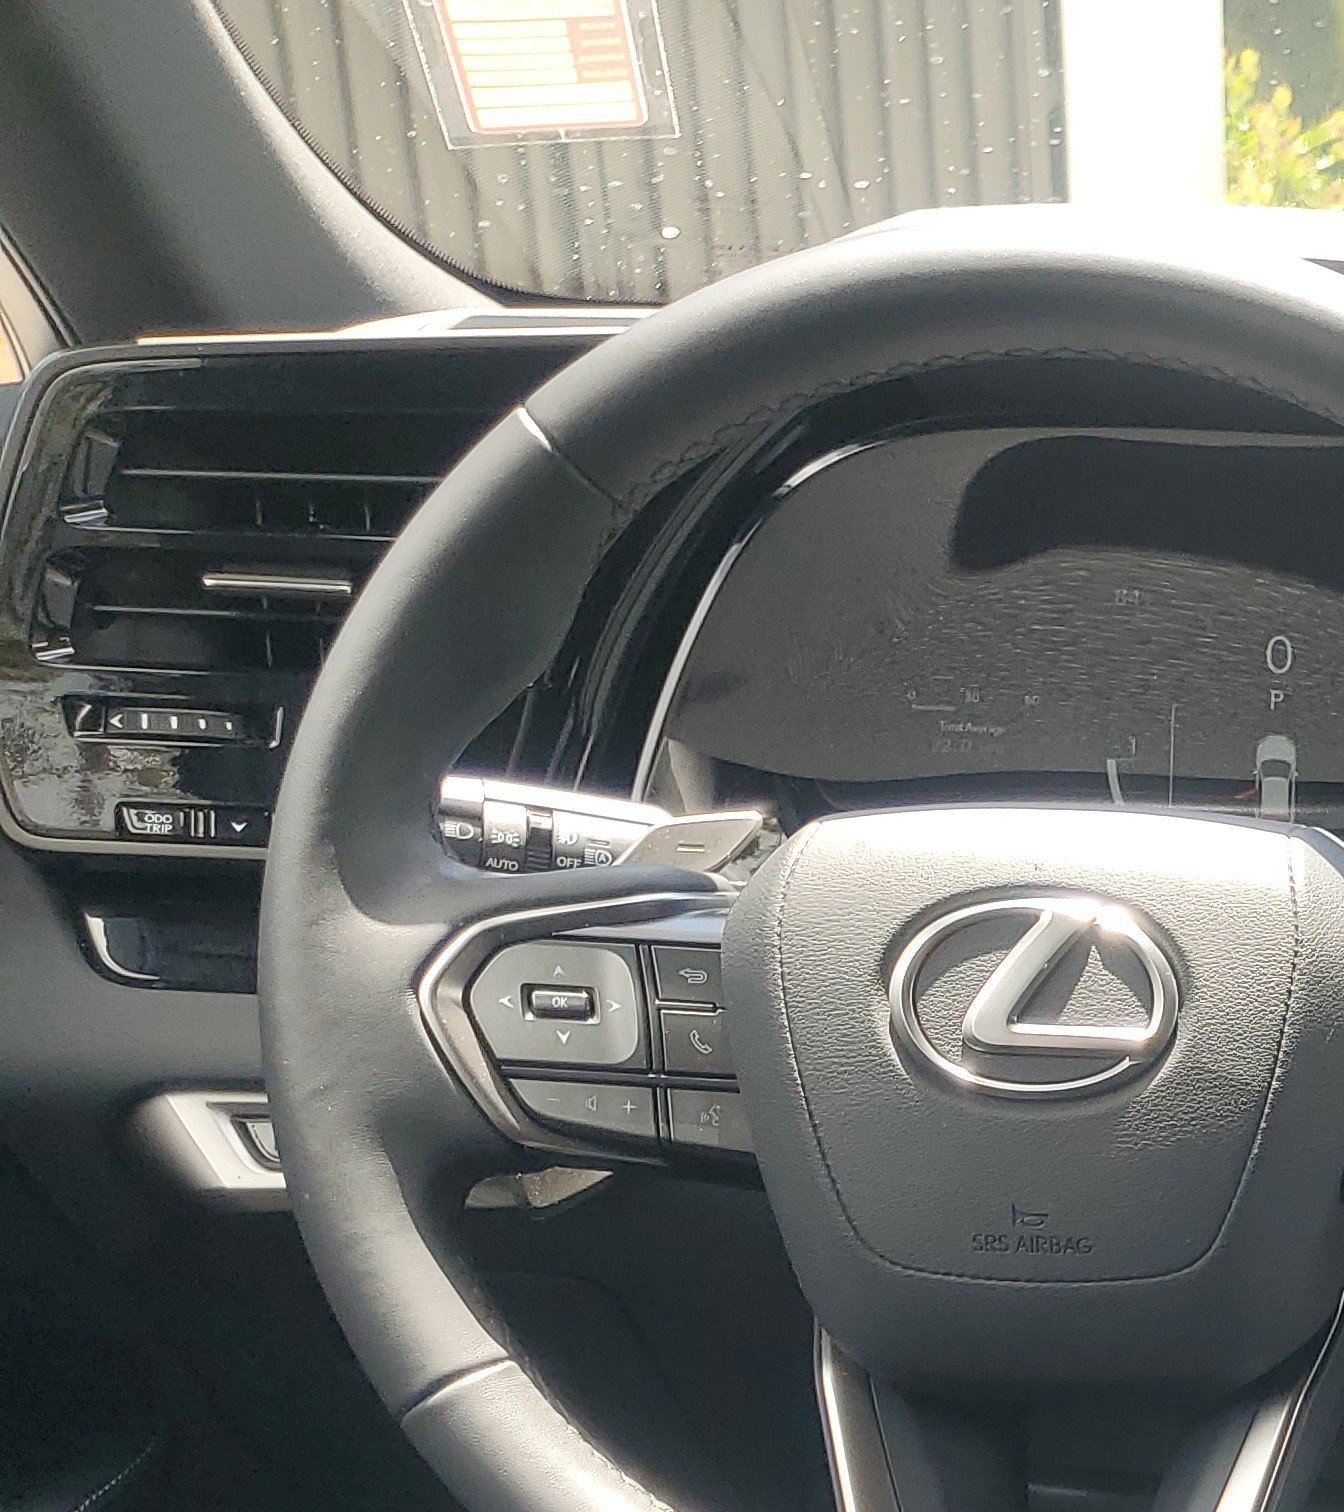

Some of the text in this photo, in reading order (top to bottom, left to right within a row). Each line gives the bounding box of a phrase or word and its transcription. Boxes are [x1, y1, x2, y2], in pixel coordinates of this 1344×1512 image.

[1265, 634, 1293, 676] 0
[1269, 690, 1284, 710] P
[144, 811, 173, 823] ODO
[146, 823, 173, 834] TRIP
[486, 857, 519, 871] AUTO
[556, 856, 583, 870] OFF
[551, 995, 569, 1010] OK
[971, 1233, 1094, 1255] SRS AIRBAG
